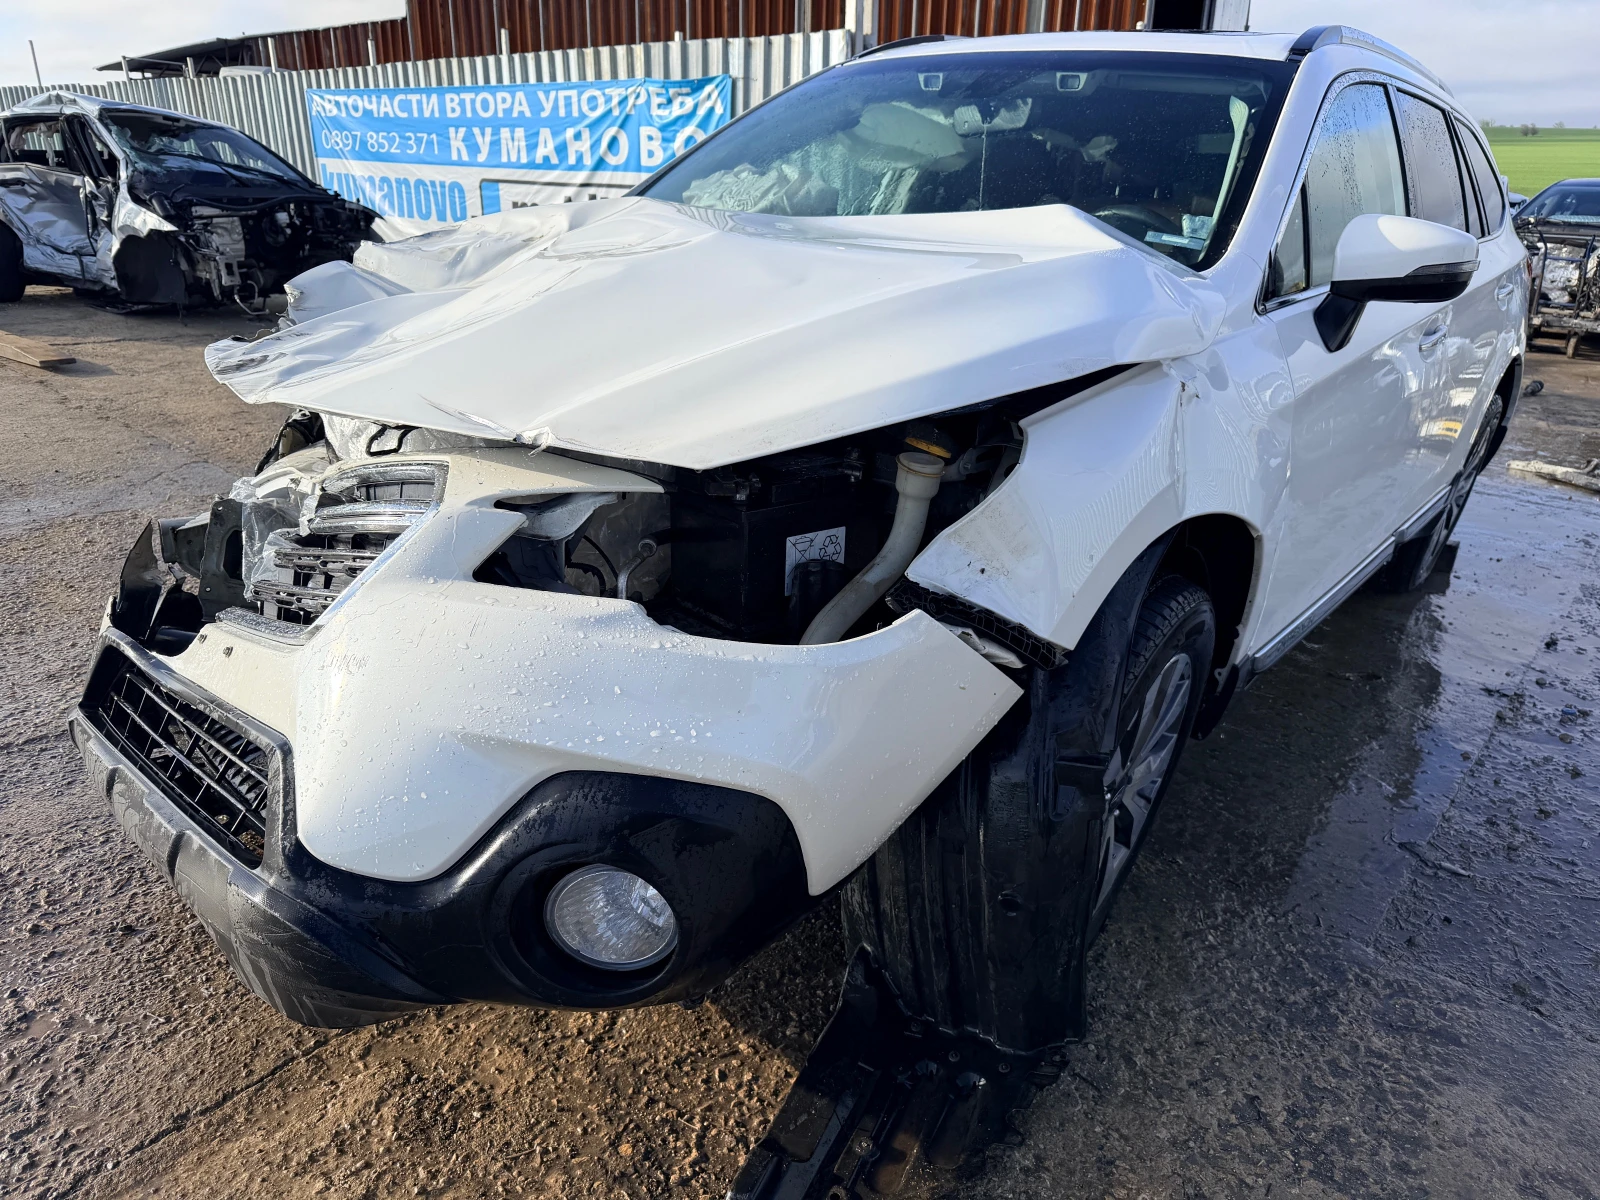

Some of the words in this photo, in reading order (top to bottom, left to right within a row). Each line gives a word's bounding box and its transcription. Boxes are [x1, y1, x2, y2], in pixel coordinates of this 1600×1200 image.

[311, 93, 440, 118] АВТОЧАСТИ
[445, 91, 532, 118] ВТОРА
[538, 84, 725, 118] УПОТРЕБА
[321, 128, 361, 152] 0897
[367, 131, 400, 154] 852
[406, 132, 439, 155] 371
